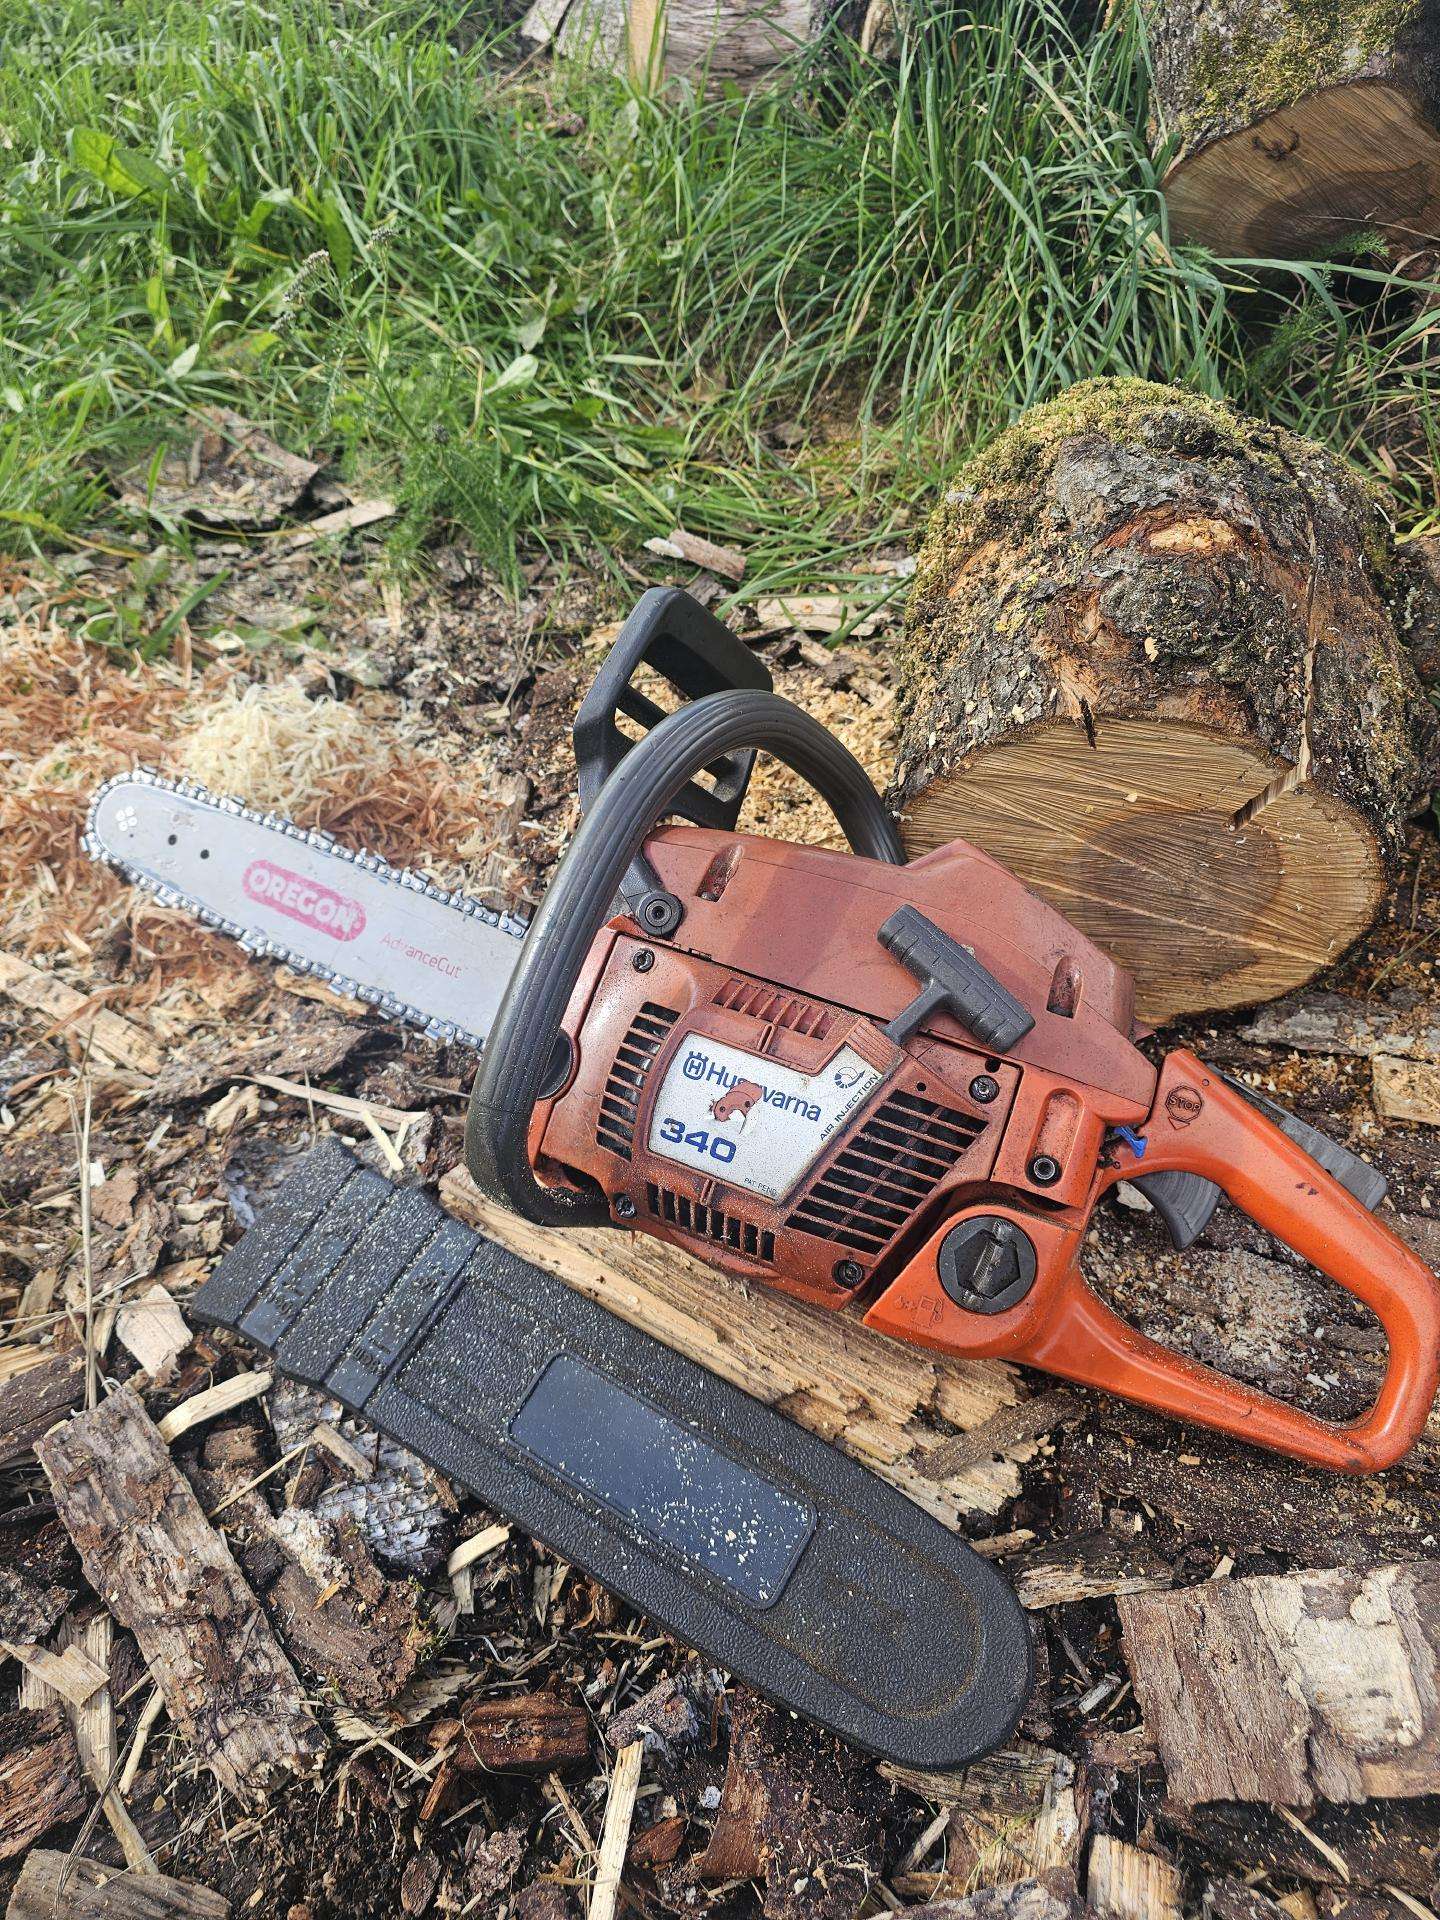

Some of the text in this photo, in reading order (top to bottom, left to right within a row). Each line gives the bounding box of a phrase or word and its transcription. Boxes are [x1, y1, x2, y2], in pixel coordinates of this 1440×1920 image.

[251, 868, 358, 929] OREGON
[379, 933, 463, 979] AdvanceCut
[706, 1062, 821, 1122] Huvarna
[820, 1073, 879, 1141] AIR INJECTION
[1169, 1095, 1200, 1111] STOP
[660, 1117, 737, 1164] 340
